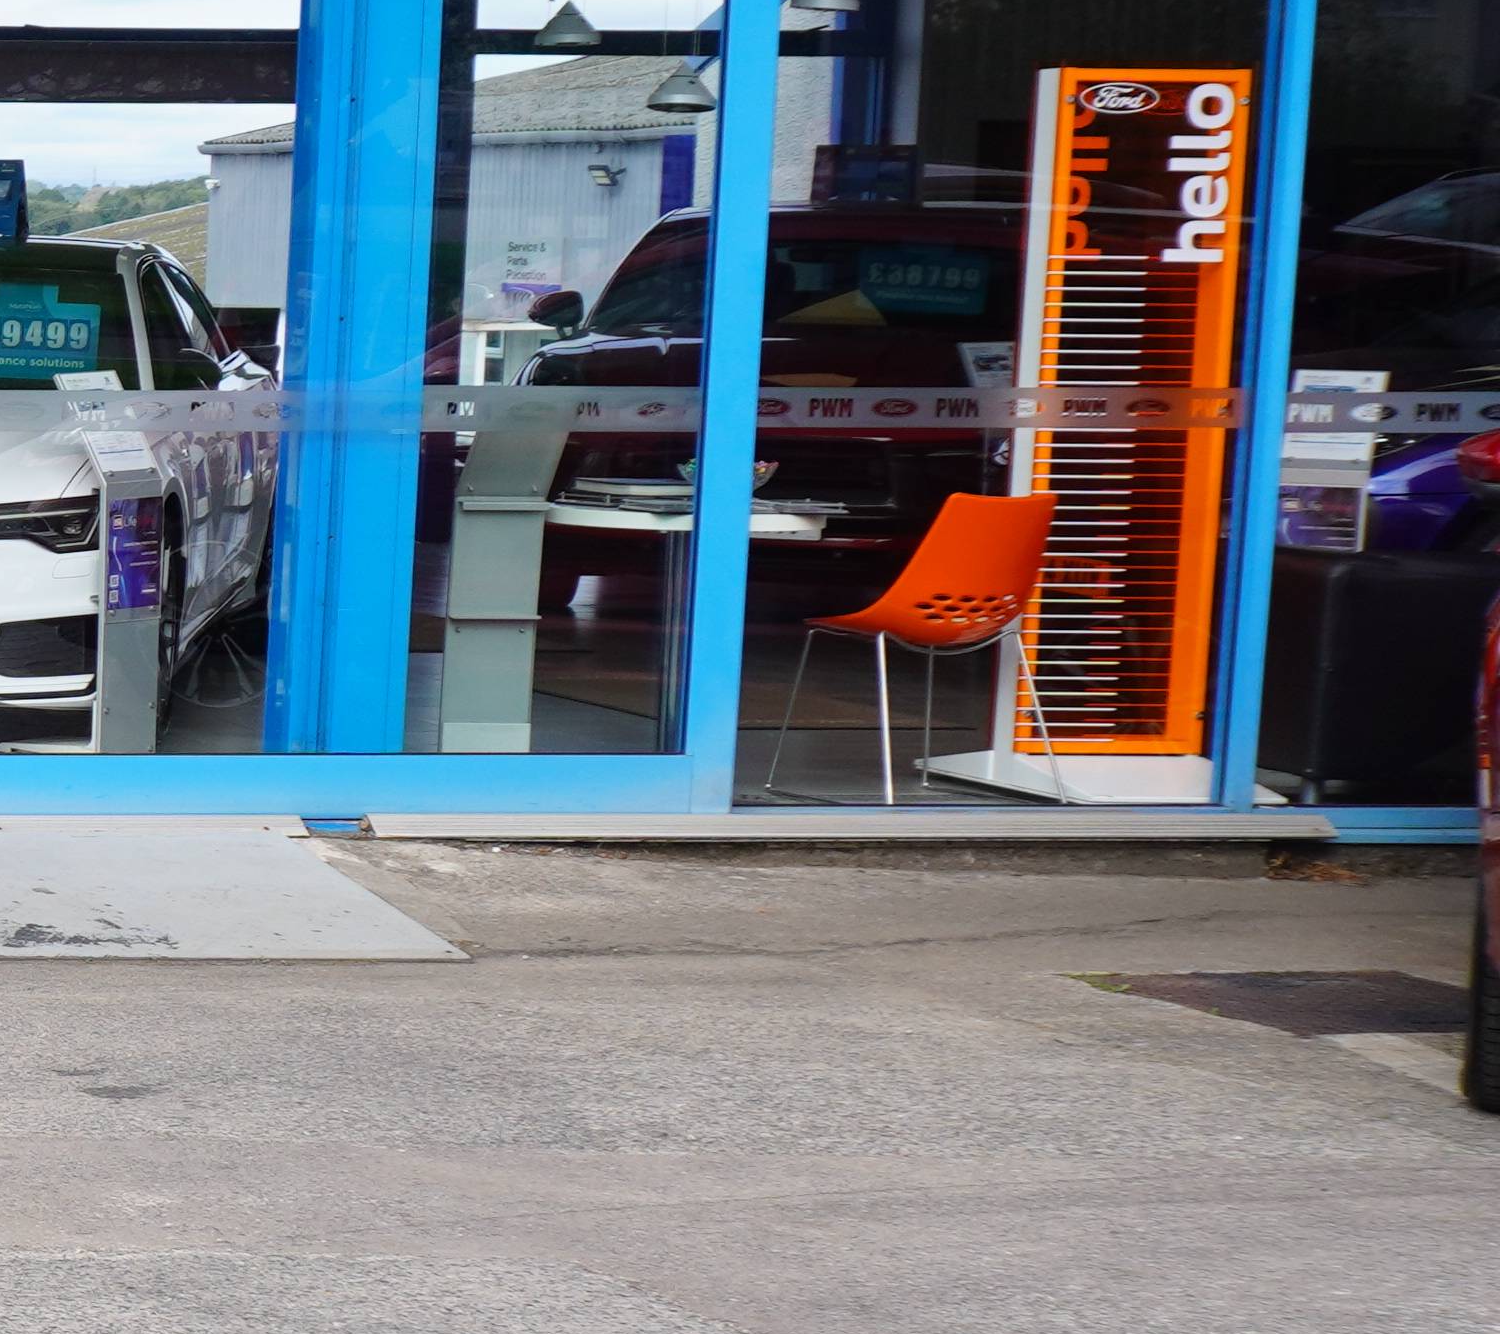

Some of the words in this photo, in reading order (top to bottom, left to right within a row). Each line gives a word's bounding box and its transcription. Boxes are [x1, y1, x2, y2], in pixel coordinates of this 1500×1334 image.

[1088, 84, 1153, 111] Ford
[1160, 82, 1236, 263] hello
[507, 241, 538, 253] Service
[29, 355, 85, 369] solutions
[809, 398, 854, 418] PWM
[936, 398, 980, 418] PWM
[1416, 403, 1462, 422] PWM
